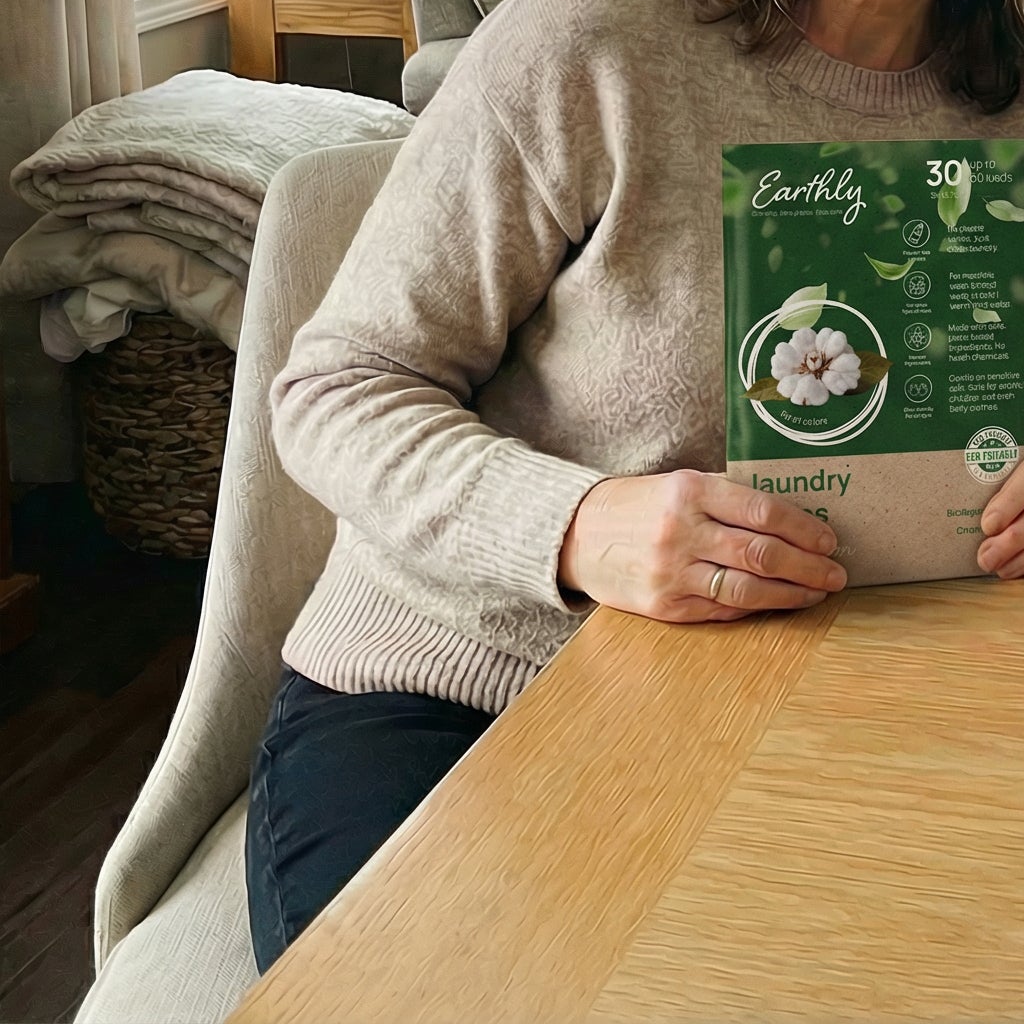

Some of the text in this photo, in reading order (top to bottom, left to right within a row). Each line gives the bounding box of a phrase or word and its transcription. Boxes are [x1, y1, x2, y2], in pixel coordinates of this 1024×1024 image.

[926, 159, 962, 187] 30
[751, 167, 867, 225] Earthly
[752, 468, 852, 497] laundry
